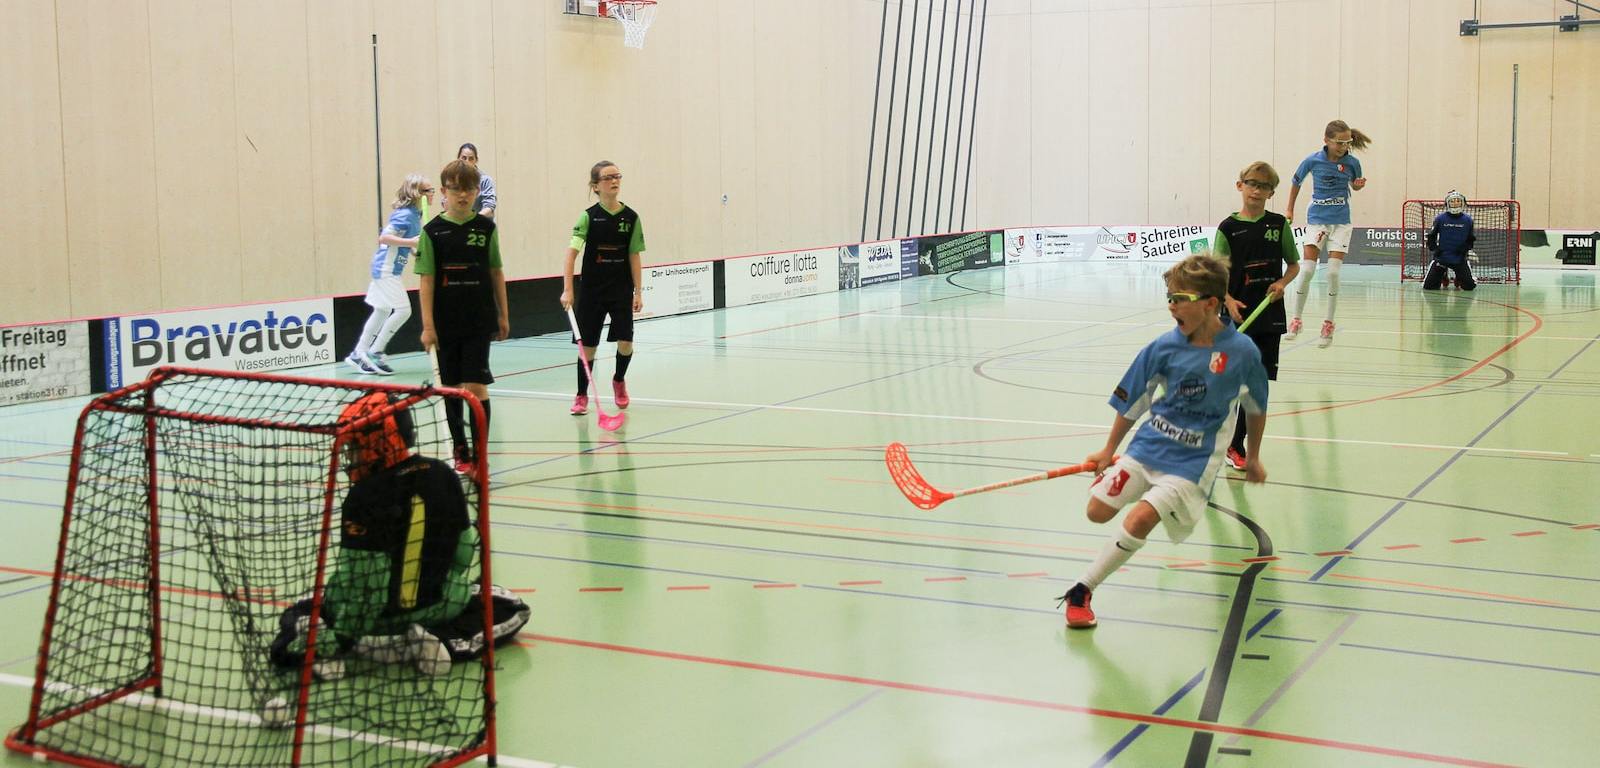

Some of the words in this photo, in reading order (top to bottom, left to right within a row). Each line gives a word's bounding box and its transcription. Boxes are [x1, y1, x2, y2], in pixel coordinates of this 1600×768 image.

[466, 233, 486, 247] 23
[1141, 226, 1202, 245] Schreiner
[1264, 229, 1280, 242] 48
[1566, 237, 1592, 247] ERNI
[1142, 241, 1186, 258] Sauter
[665, 265, 709, 276] Unihockeyprofi
[750, 256, 790, 277] coiffure
[793, 253, 818, 272] liotta
[2, 327, 66, 347] Freitag
[131, 310, 328, 367] Bravatec
[0, 353, 46, 372] ffnet
[235, 353, 310, 370] Wassertechnik
[314, 349, 329, 360] AG
